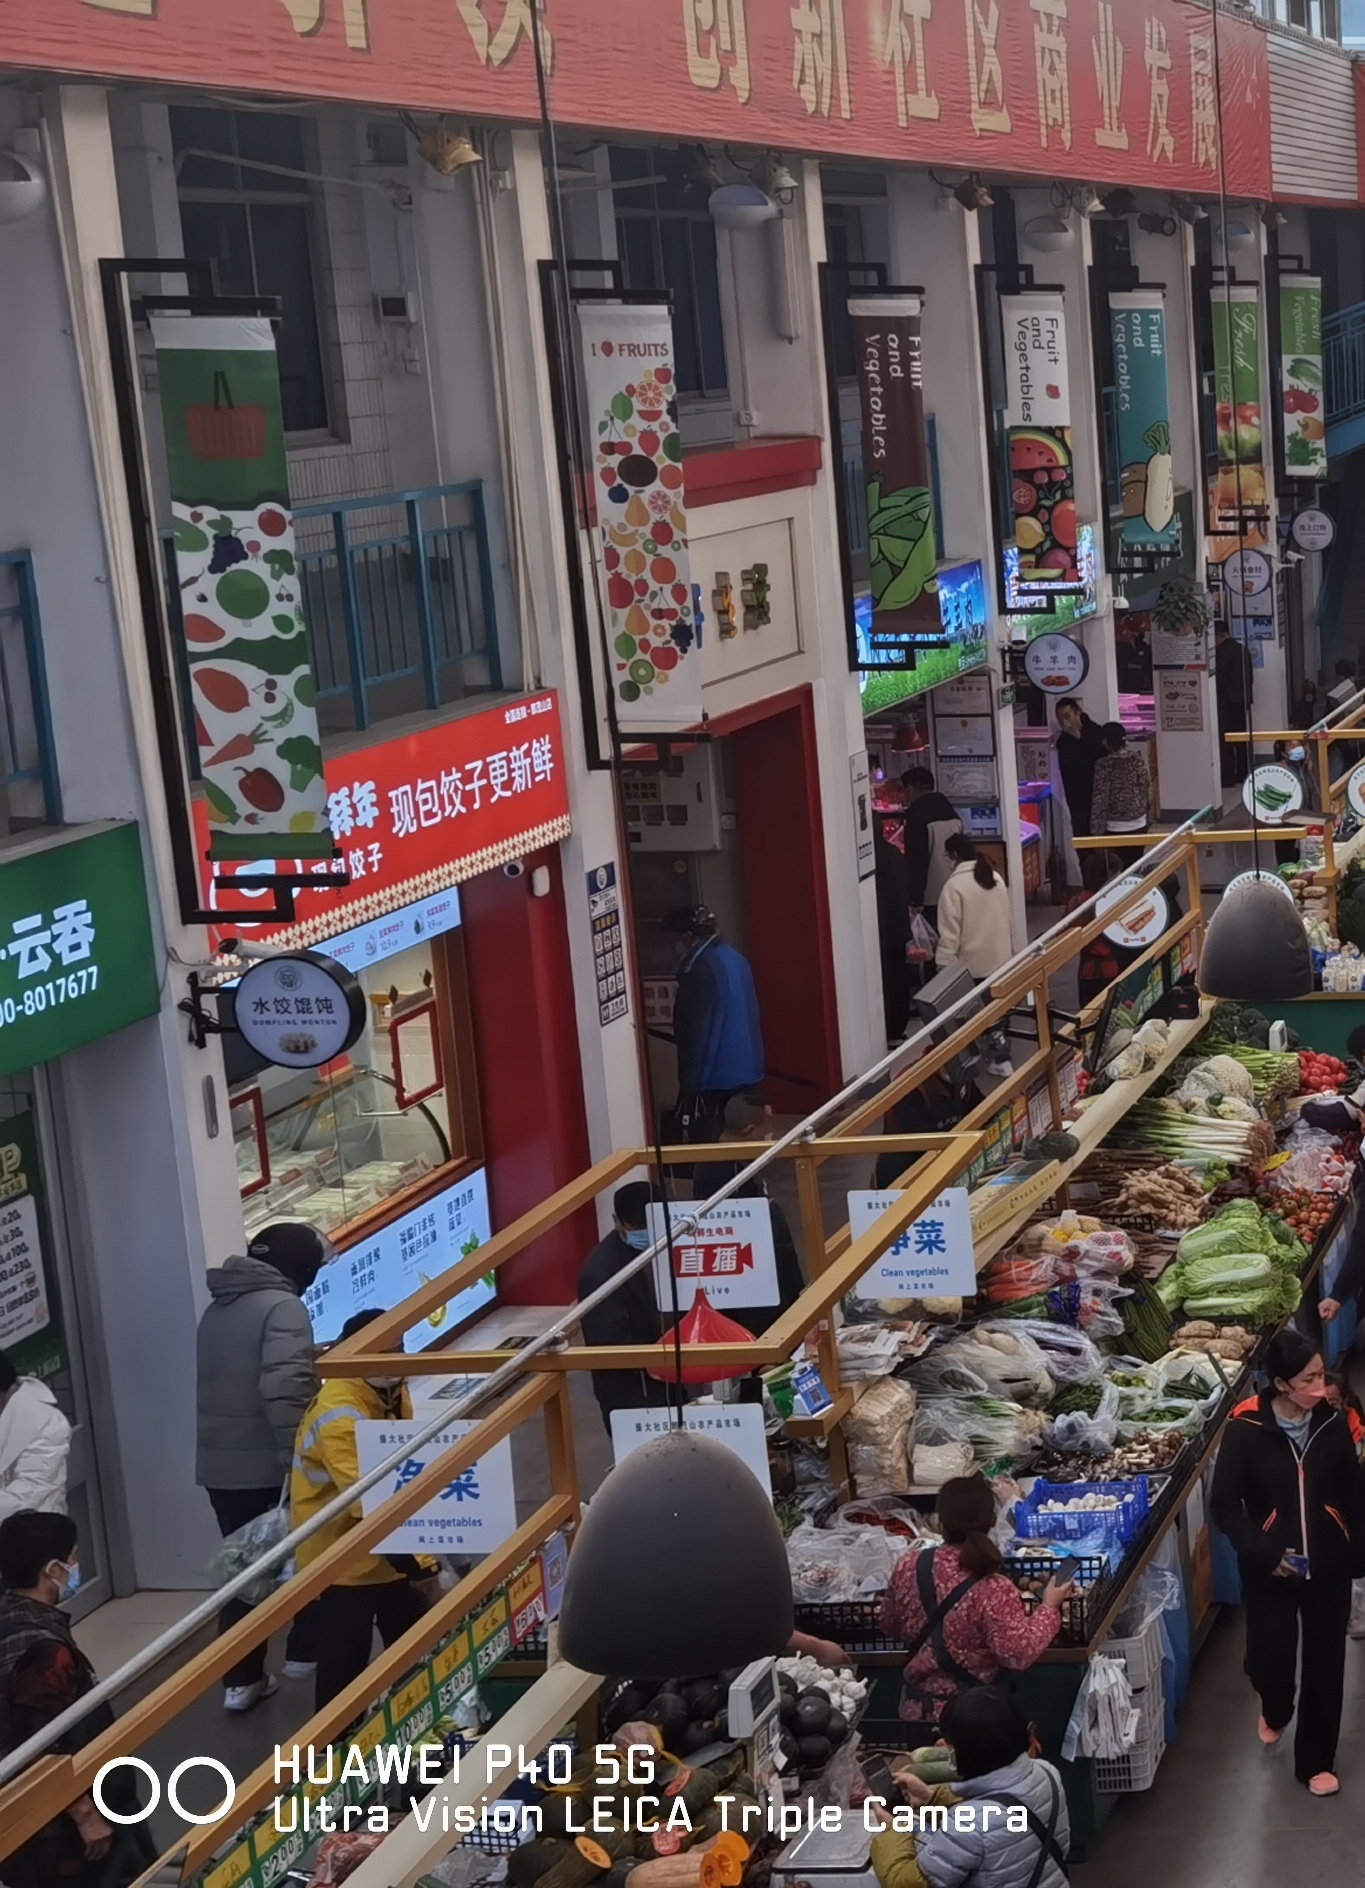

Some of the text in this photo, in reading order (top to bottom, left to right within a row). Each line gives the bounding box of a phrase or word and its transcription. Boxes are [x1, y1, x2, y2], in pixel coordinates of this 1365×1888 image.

[1030, 315, 1044, 350] and
[1043, 316, 1060, 366] Fruit
[1131, 312, 1146, 348] and
[1148, 312, 1163, 358] Fruit
[617, 342, 670, 357] FRUITS
[886, 334, 905, 382] and
[908, 335, 923, 390] Fruit
[1113, 312, 1132, 412] Vegetables
[1016, 317, 1033, 423] Vegetables
[864, 333, 886, 460] Vegetables
[1031, 654, 1077, 665] 牛羊肉
[388, 733, 553, 838] 现包饺子更新鲜
[250, 996, 334, 1016] 水饺馄饨
[679, 1244, 739, 1275] 直播
[880, 1266, 950, 1279] Clean vegetables
[703, 1285, 731, 1296] Live
[430, 1515, 484, 1529] vegetables
